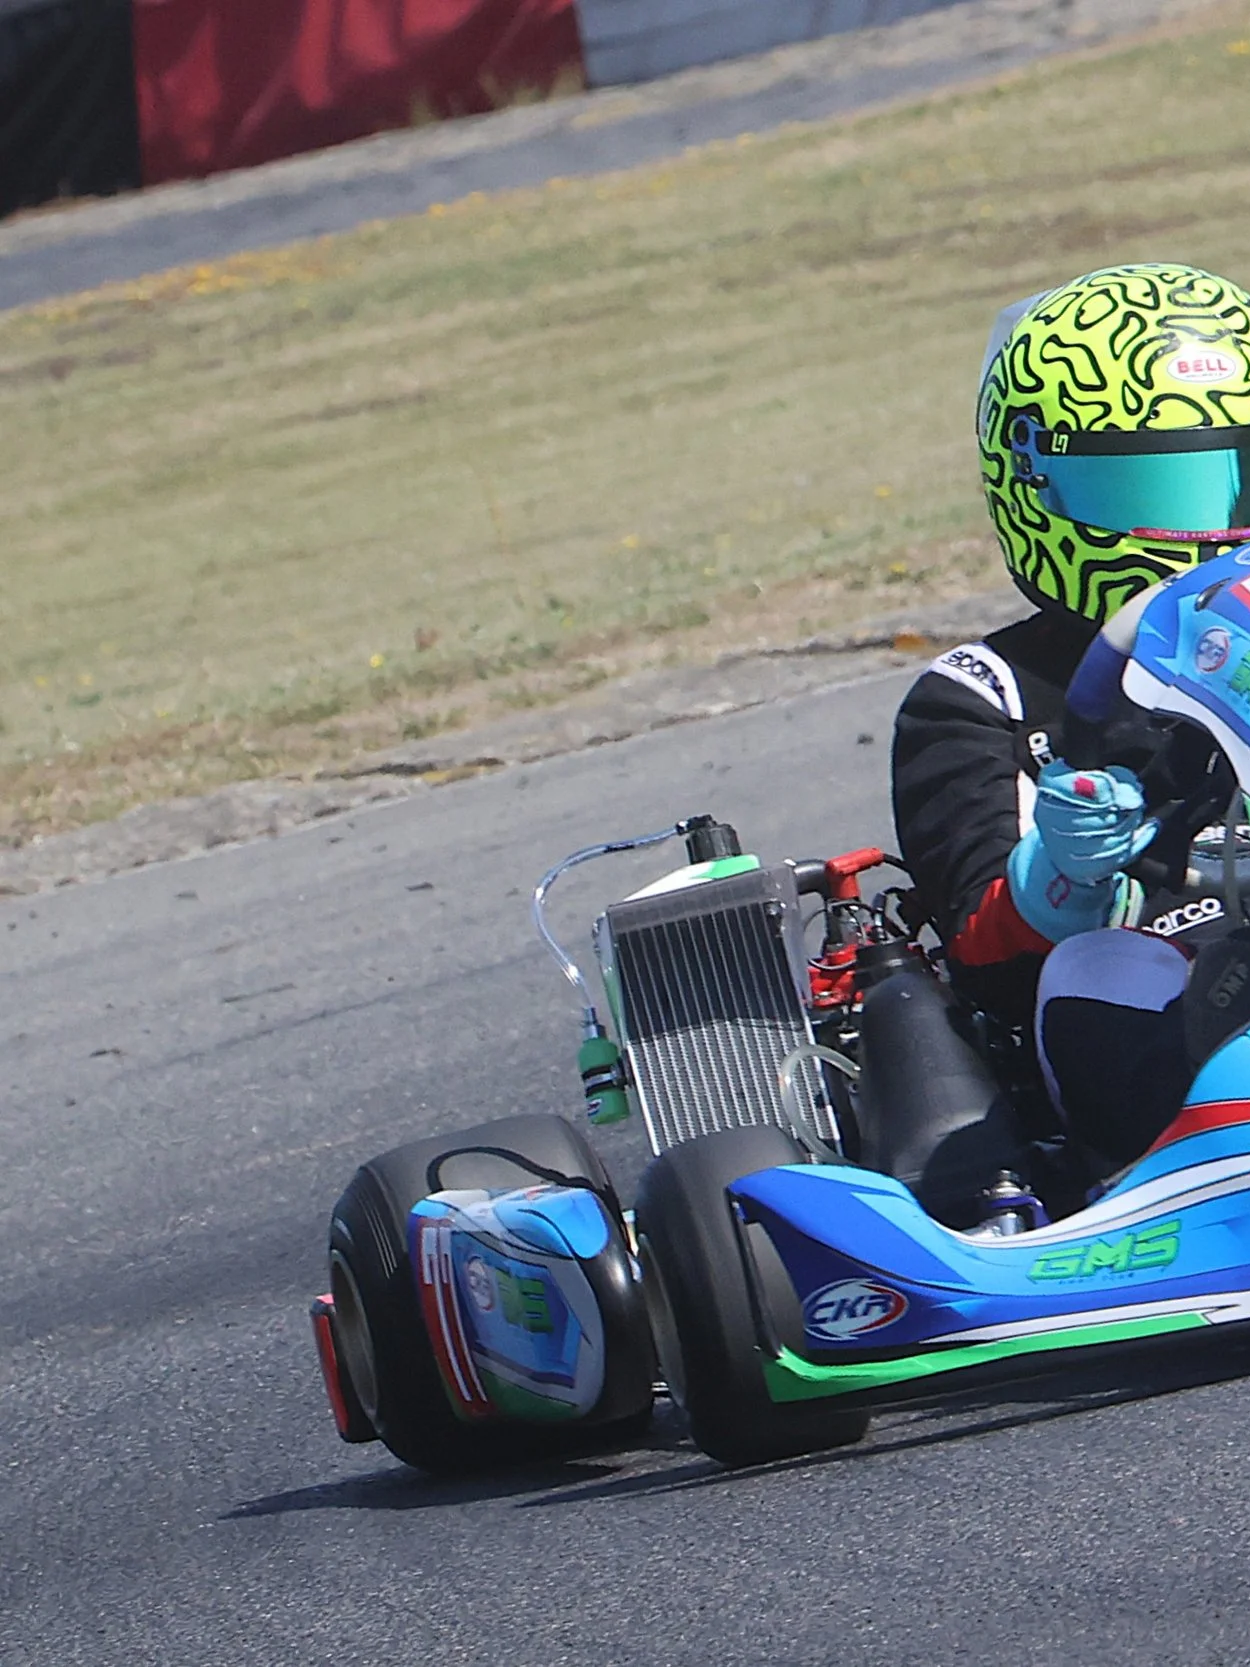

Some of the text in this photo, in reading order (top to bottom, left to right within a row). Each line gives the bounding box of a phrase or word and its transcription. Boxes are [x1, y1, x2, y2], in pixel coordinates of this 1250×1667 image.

[1177, 358, 1228, 373] BELL
[1029, 1218, 1181, 1280] GMS
[808, 1294, 891, 1325] CKR
